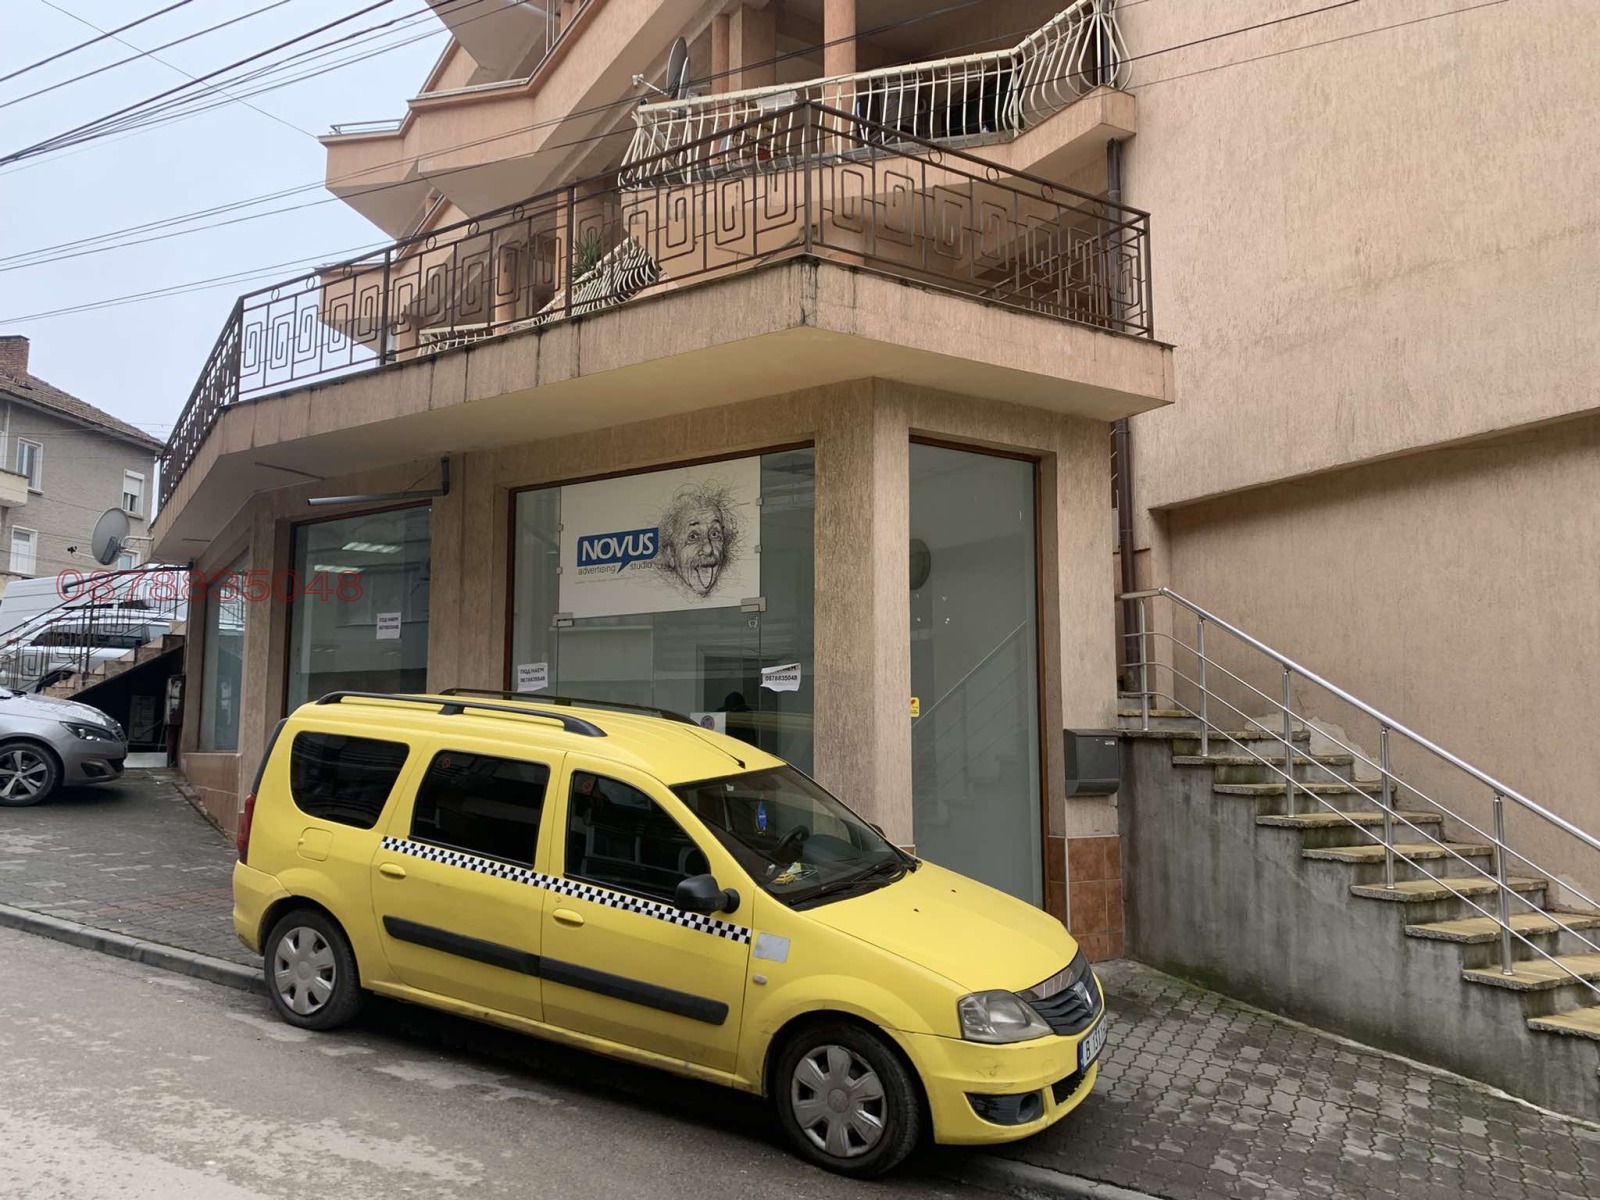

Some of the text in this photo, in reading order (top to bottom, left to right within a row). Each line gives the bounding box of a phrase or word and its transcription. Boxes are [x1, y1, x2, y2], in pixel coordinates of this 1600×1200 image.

[582, 533, 654, 561] NOVUS
[578, 560, 653, 575] advertising studio
